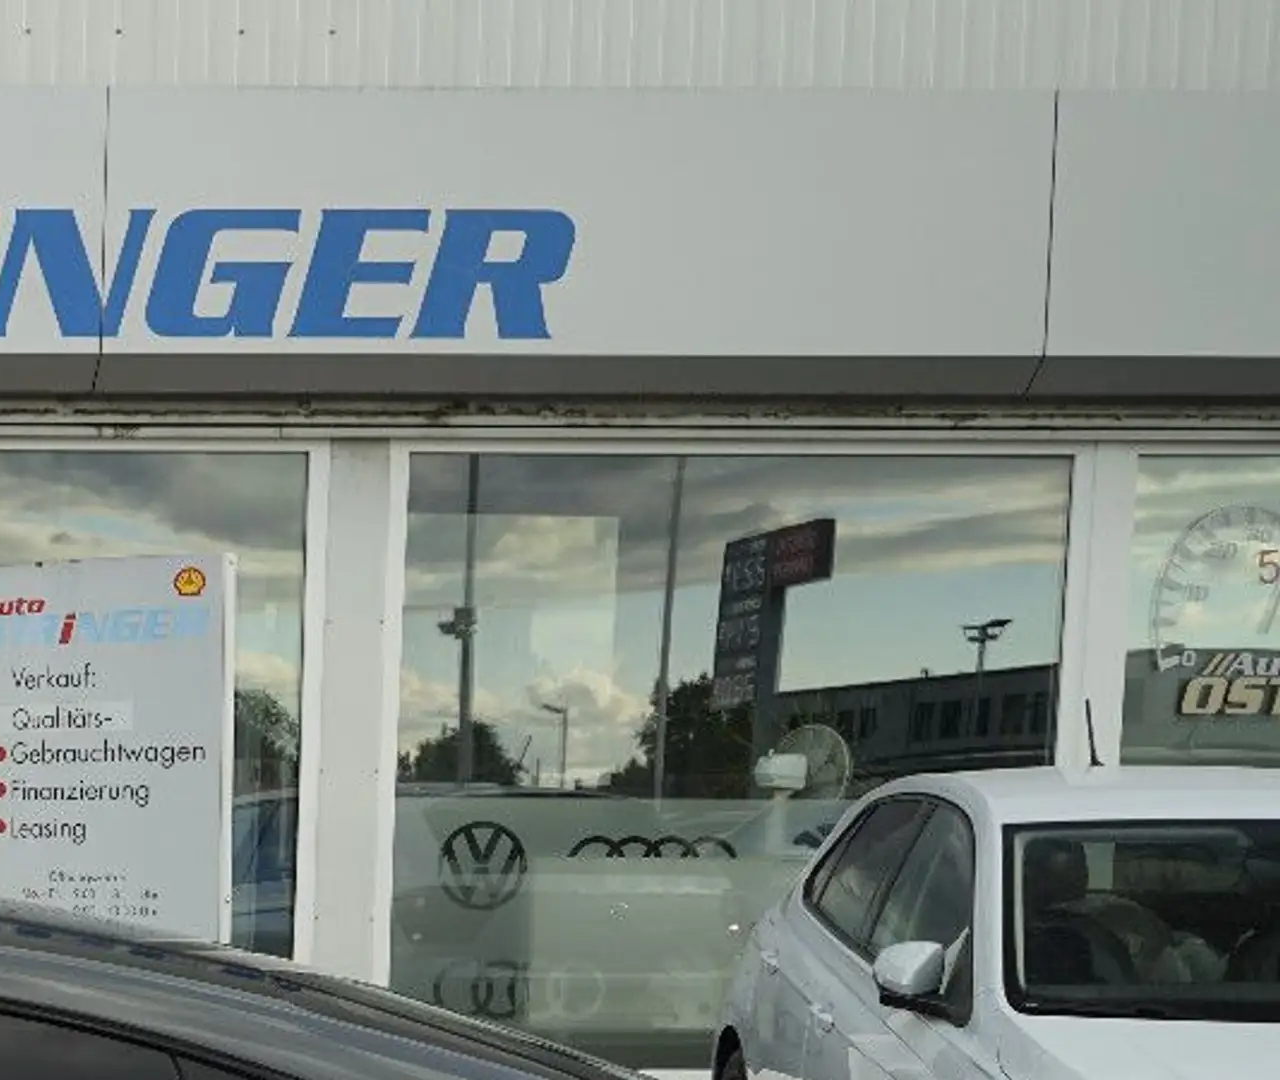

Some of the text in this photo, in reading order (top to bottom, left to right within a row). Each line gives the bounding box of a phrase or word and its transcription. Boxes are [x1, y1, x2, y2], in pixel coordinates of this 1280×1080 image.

[11, 662, 97, 690] Verkauf:
[1228, 651, 1280, 677] Au
[1180, 675, 1280, 716] OS
[11, 706, 114, 731] Qualitäts-
[9, 738, 207, 770] Gebrauchtwagen
[11, 778, 151, 808] Finanzierung
[10, 820, 88, 846] Leasing
